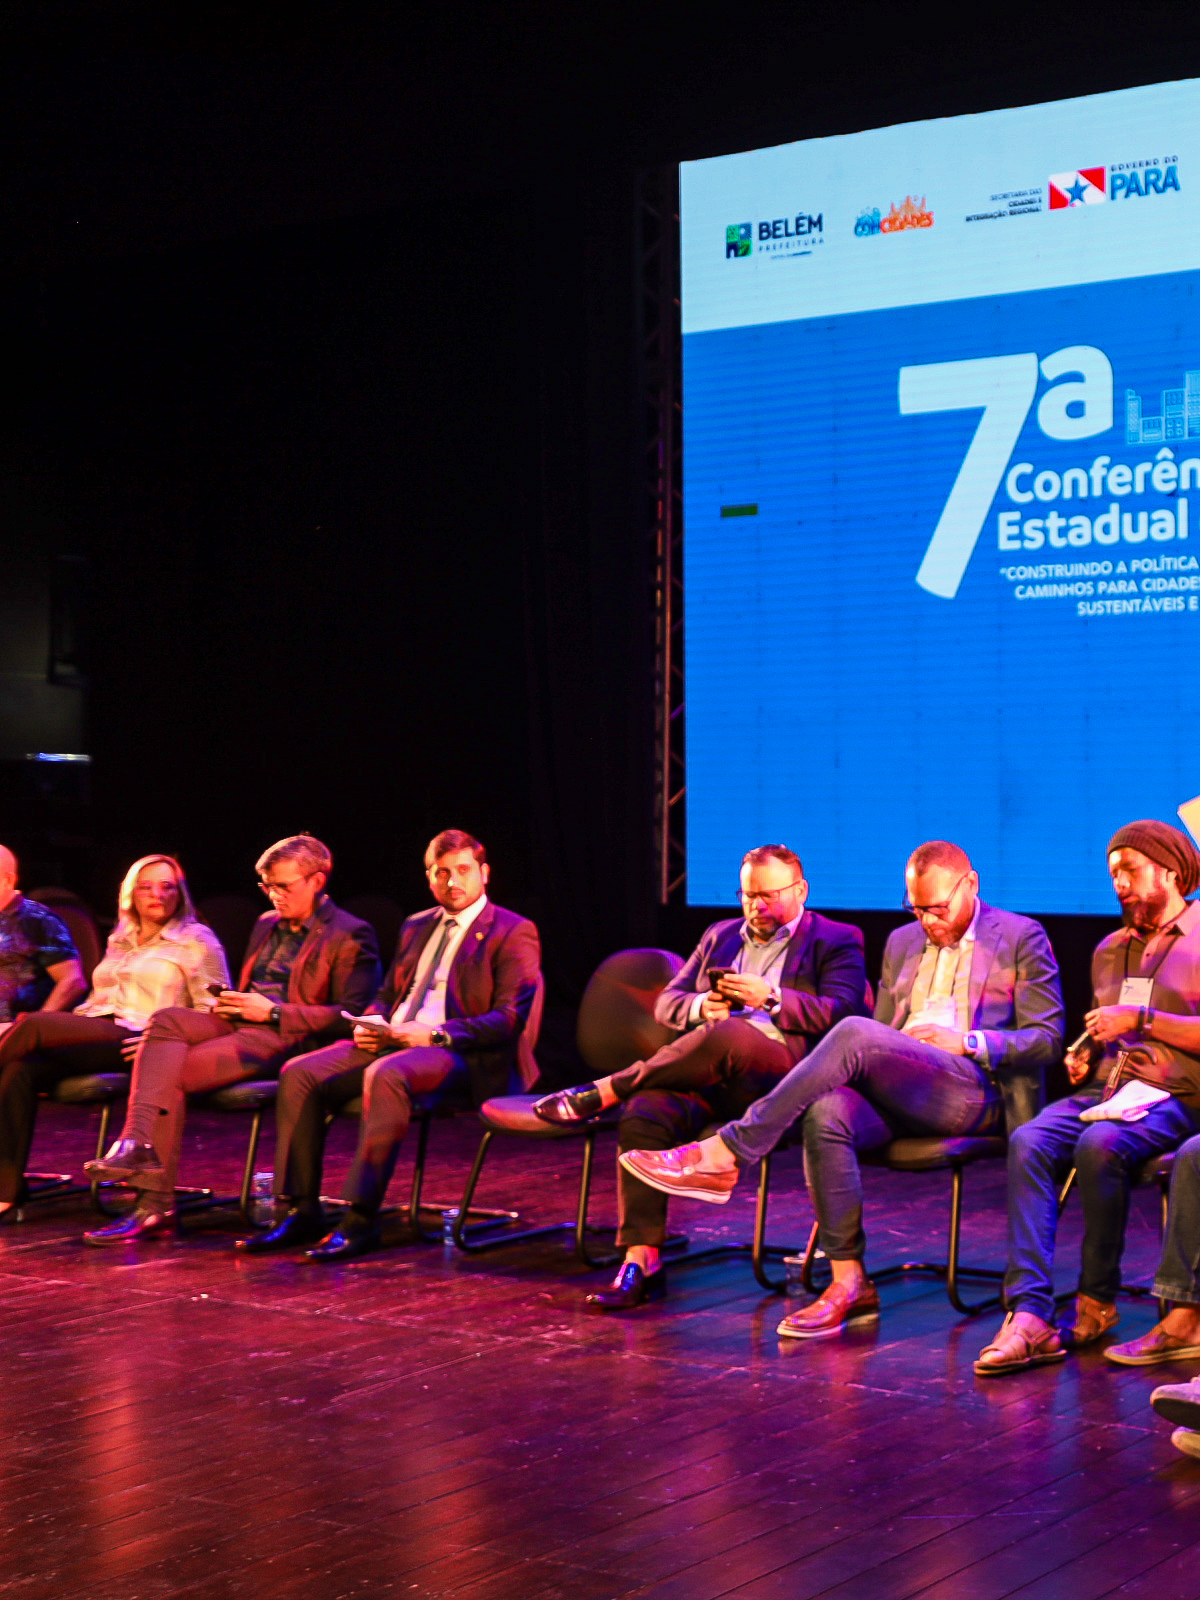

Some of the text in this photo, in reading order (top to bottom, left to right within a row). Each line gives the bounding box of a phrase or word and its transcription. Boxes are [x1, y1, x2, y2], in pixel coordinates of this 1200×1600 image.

[758, 211, 823, 241] BELÉM
[998, 497, 1189, 551] Estadual
[1116, 561, 1128, 573] A
[1131, 555, 1199, 573] POLÍTICA
[1015, 581, 1094, 599] CAMINHOS
[1098, 580, 1138, 595] PARA
[1077, 596, 1186, 616] SUSTENTÁVEIS
[1189, 596, 1199, 611] E
